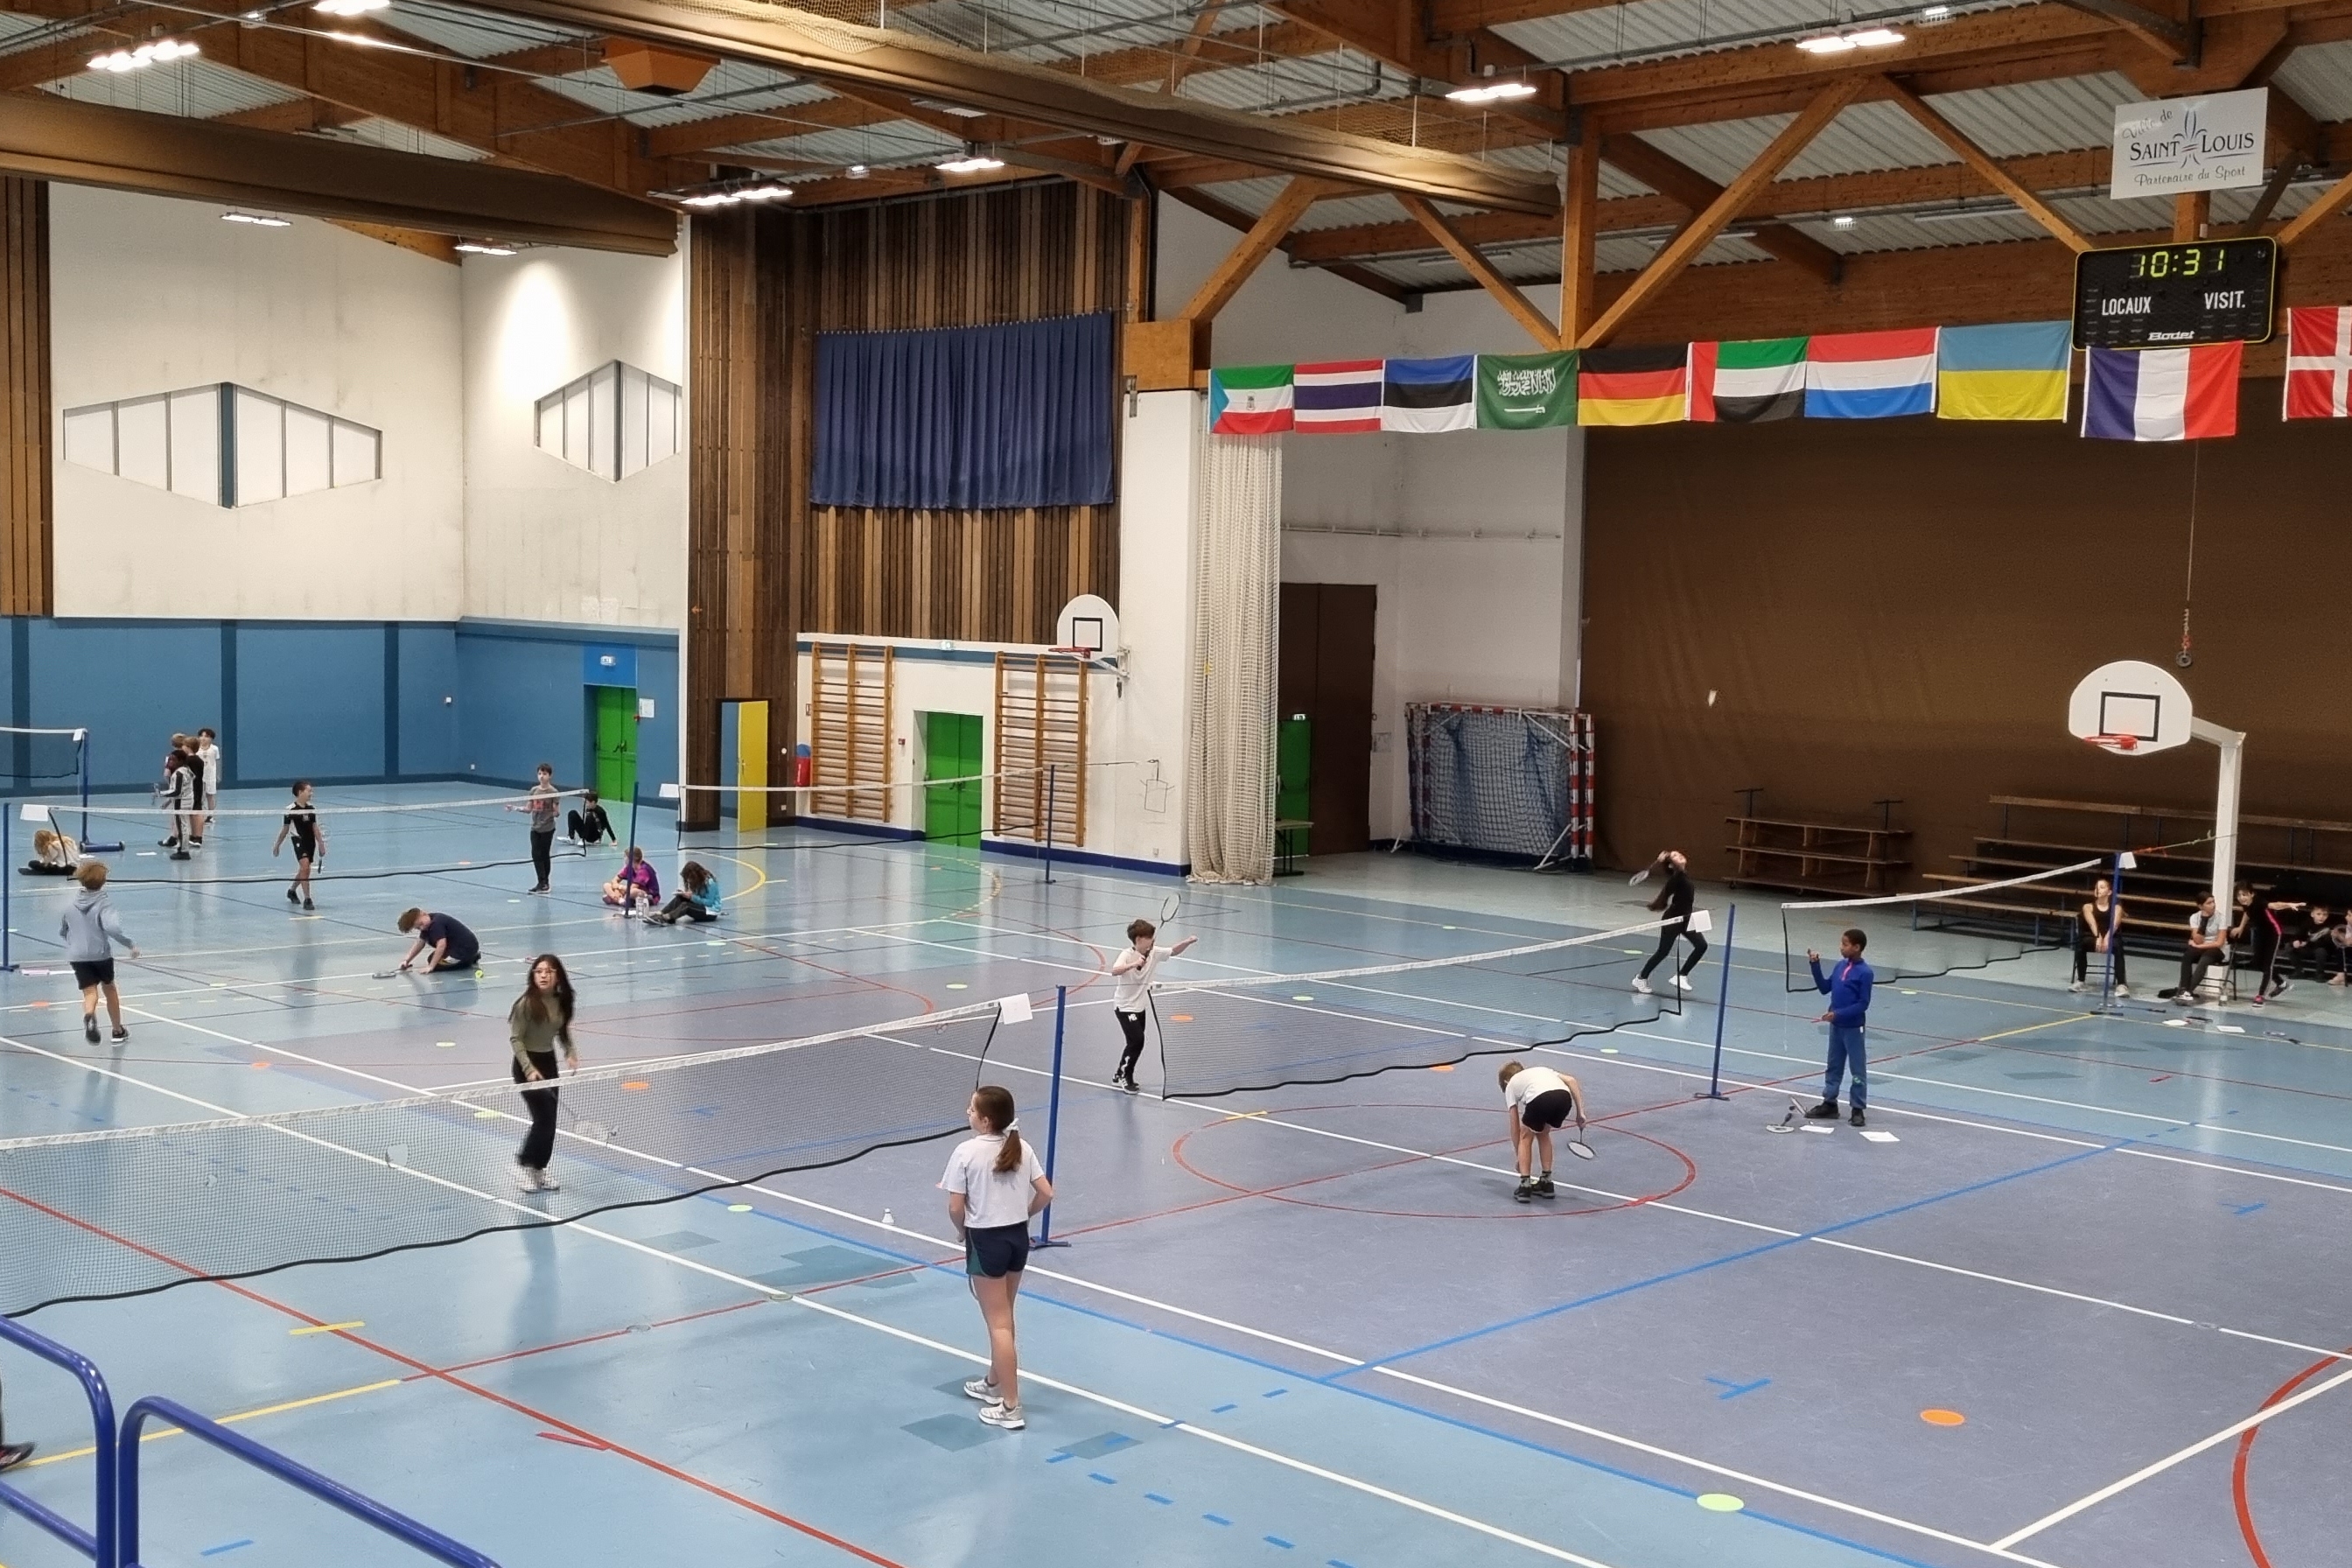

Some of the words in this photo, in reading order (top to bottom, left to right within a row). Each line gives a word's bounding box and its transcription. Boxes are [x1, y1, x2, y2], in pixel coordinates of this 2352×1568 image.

[2160, 108, 2173, 122] de
[2130, 140, 2180, 161] SAINT
[2202, 132, 2254, 153] LOUIS
[2134, 172, 2193, 186] Partenaire
[2198, 168, 2210, 180] du
[2216, 164, 2245, 180] Sport
[2138, 248, 2224, 277] 10:31
[2102, 296, 2152, 316] LOCAUX
[2204, 290, 2246, 310] VISIT.
[2147, 331, 2195, 341] Bodet
